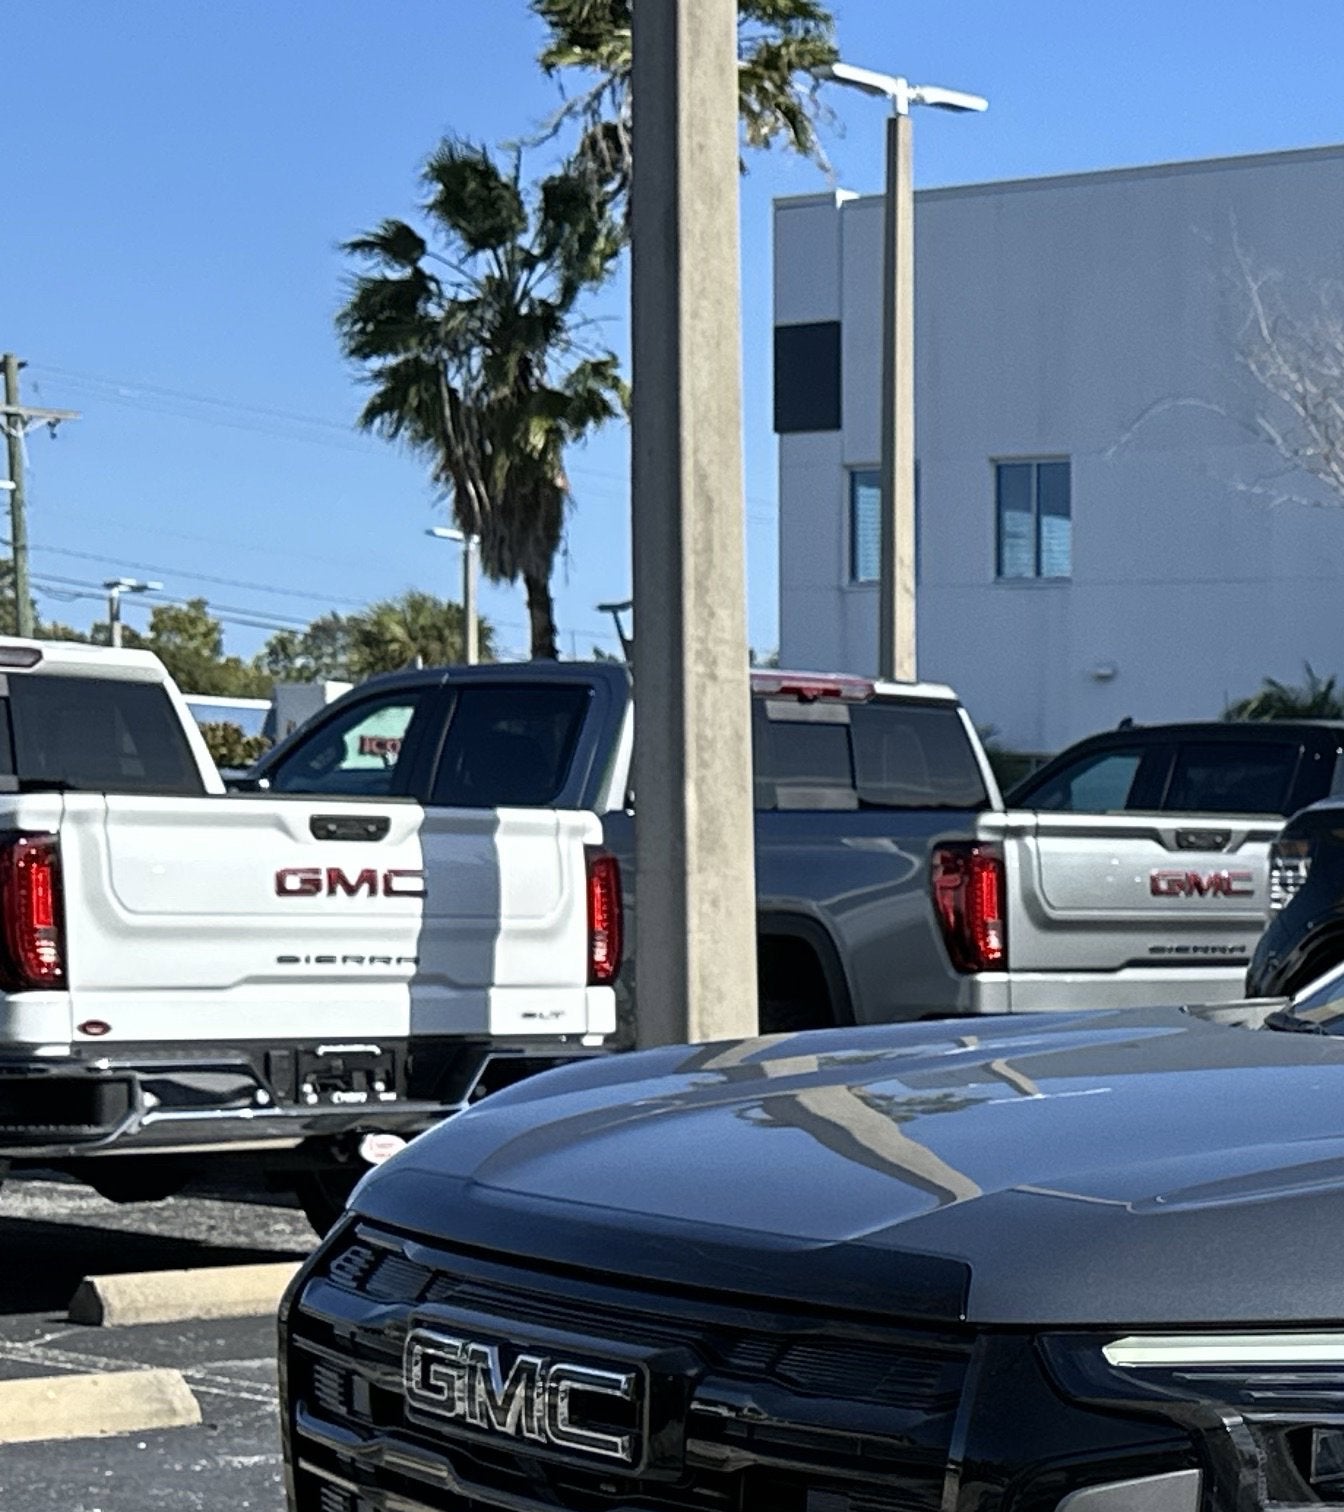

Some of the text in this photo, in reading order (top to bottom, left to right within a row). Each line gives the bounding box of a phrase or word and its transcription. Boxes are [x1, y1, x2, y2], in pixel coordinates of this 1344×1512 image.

[275, 867, 427, 897] GMC
[1150, 870, 1255, 897] GMC
[402, 1328, 636, 1463] GMC
